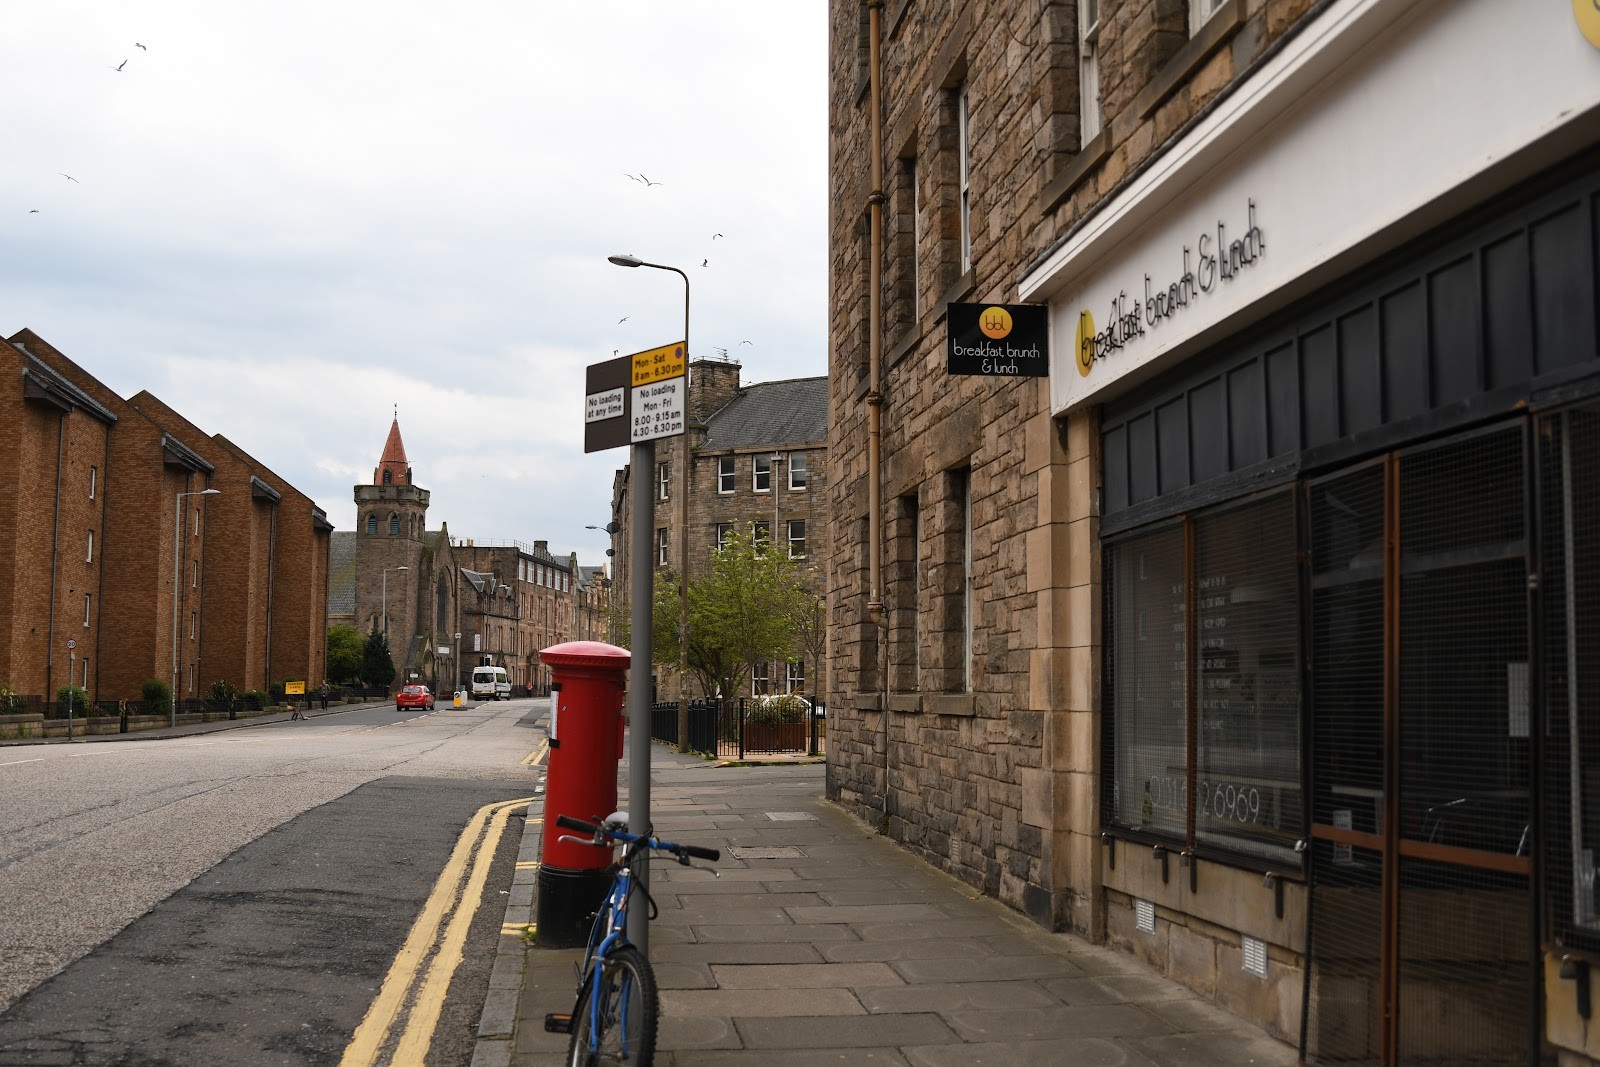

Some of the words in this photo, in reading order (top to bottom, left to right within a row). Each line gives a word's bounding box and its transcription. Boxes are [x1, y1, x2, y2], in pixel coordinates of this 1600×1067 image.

[1144, 272, 1197, 326] brunch
[1198, 233, 1215, 292] &
[1218, 197, 1265, 281] lunch
[985, 314, 1006, 331] bbl
[1006, 341, 1040, 358] brunch
[635, 360, 649, 369] Mon
[654, 354, 665, 364] Sat
[981, 358, 993, 374] &
[994, 358, 1019, 374] lunch
[635, 372, 639, 381] 8
[640, 372, 650, 380] am
[655, 365, 670, 376] 6.30
[671, 364, 682, 374] pm
[640, 389, 650, 398] No
[651, 384, 675, 395] loading
[588, 398, 597, 407] No
[599, 393, 621, 404] loading
[643, 402, 658, 411] Mon
[662, 397, 672, 407] Fri
[588, 409, 594, 418] at
[595, 408, 606, 417] any
[608, 404, 621, 413] time
[635, 414, 651, 426] 8.00
[655, 411, 670, 422] 9.15
[670, 411, 681, 419] am
[633, 427, 649, 437] 4.30
[654, 422, 670, 433] 6.30
[671, 422, 682, 432] pm
